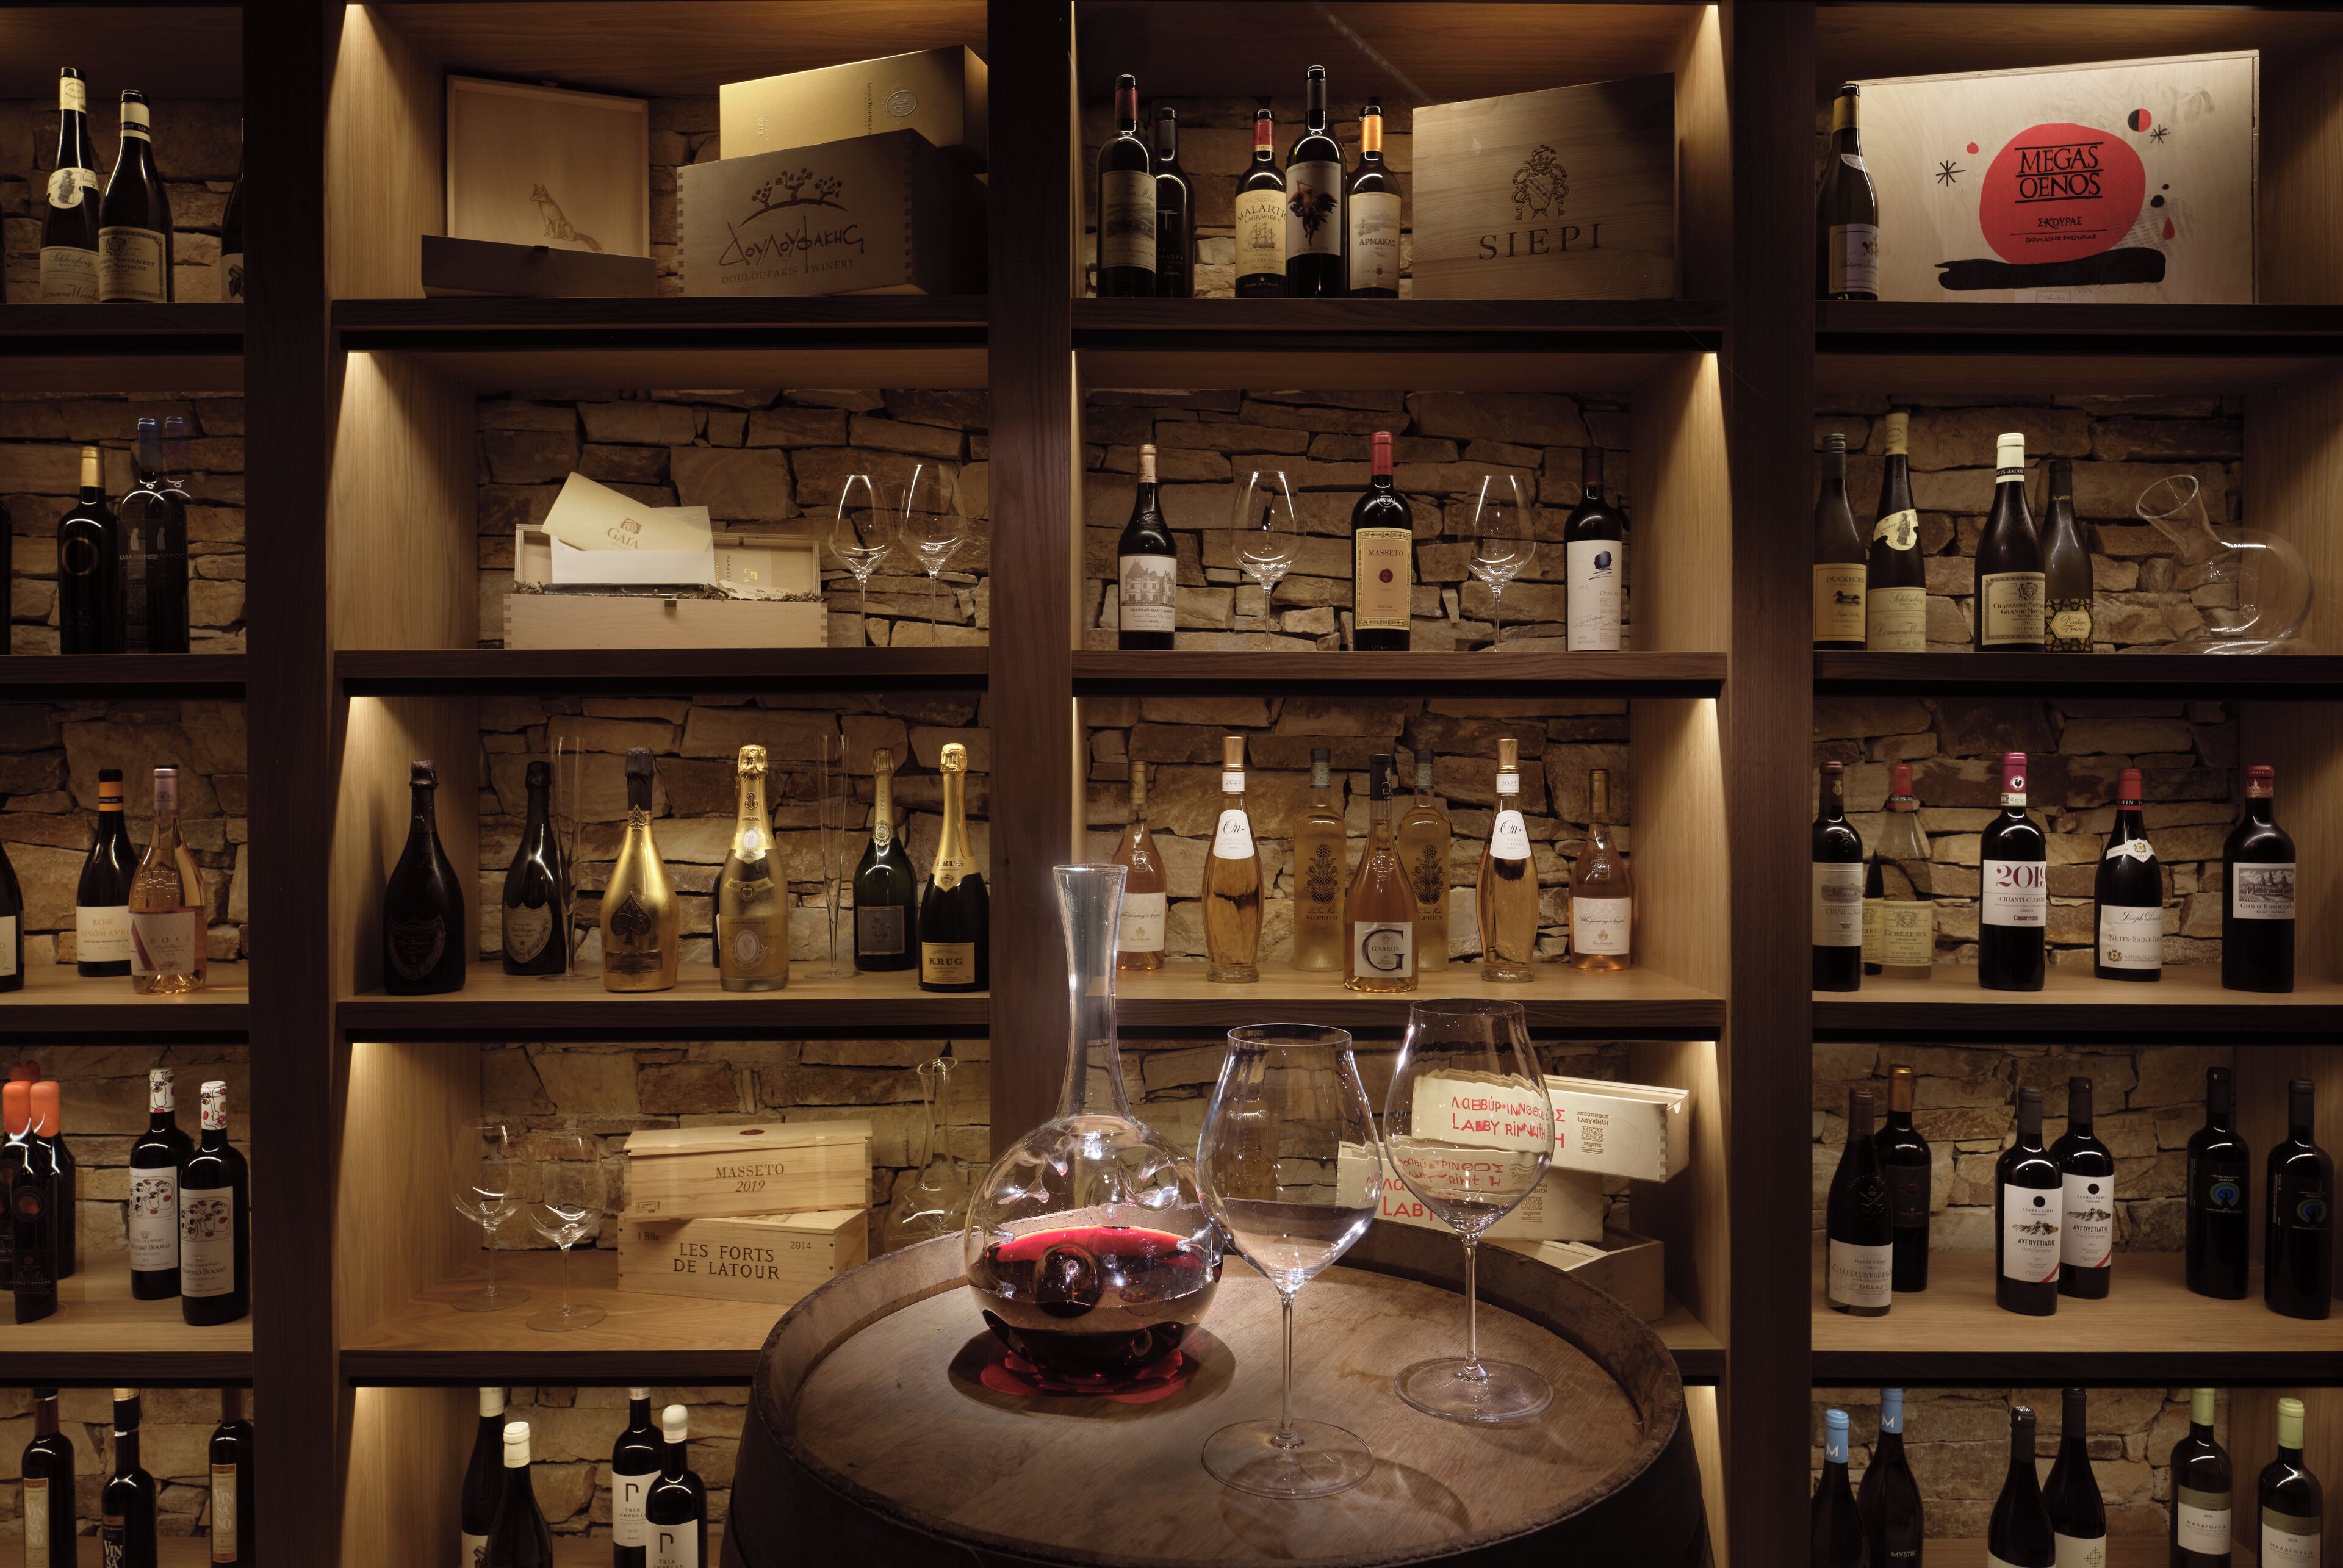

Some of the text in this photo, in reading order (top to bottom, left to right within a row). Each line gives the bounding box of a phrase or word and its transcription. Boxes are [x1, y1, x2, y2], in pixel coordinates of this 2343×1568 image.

[2018, 145, 2098, 174] MEGAS
[2019, 173, 2101, 199] OENOS
[1478, 223, 1602, 261] SIEPI
[722, 258, 855, 285] DOULOUFAKIS WINERY
[1581, 1127, 1603, 1135] MEGAS
[1582, 1132, 1605, 1142] OENOS
[716, 1163, 785, 1178] MASSETO
[735, 1179, 766, 1192] 2019
[679, 1240, 812, 1263] LES FORTS 2014
[673, 1259, 780, 1280] DE LATOUR
[104, 1539, 123, 1558] VIN
